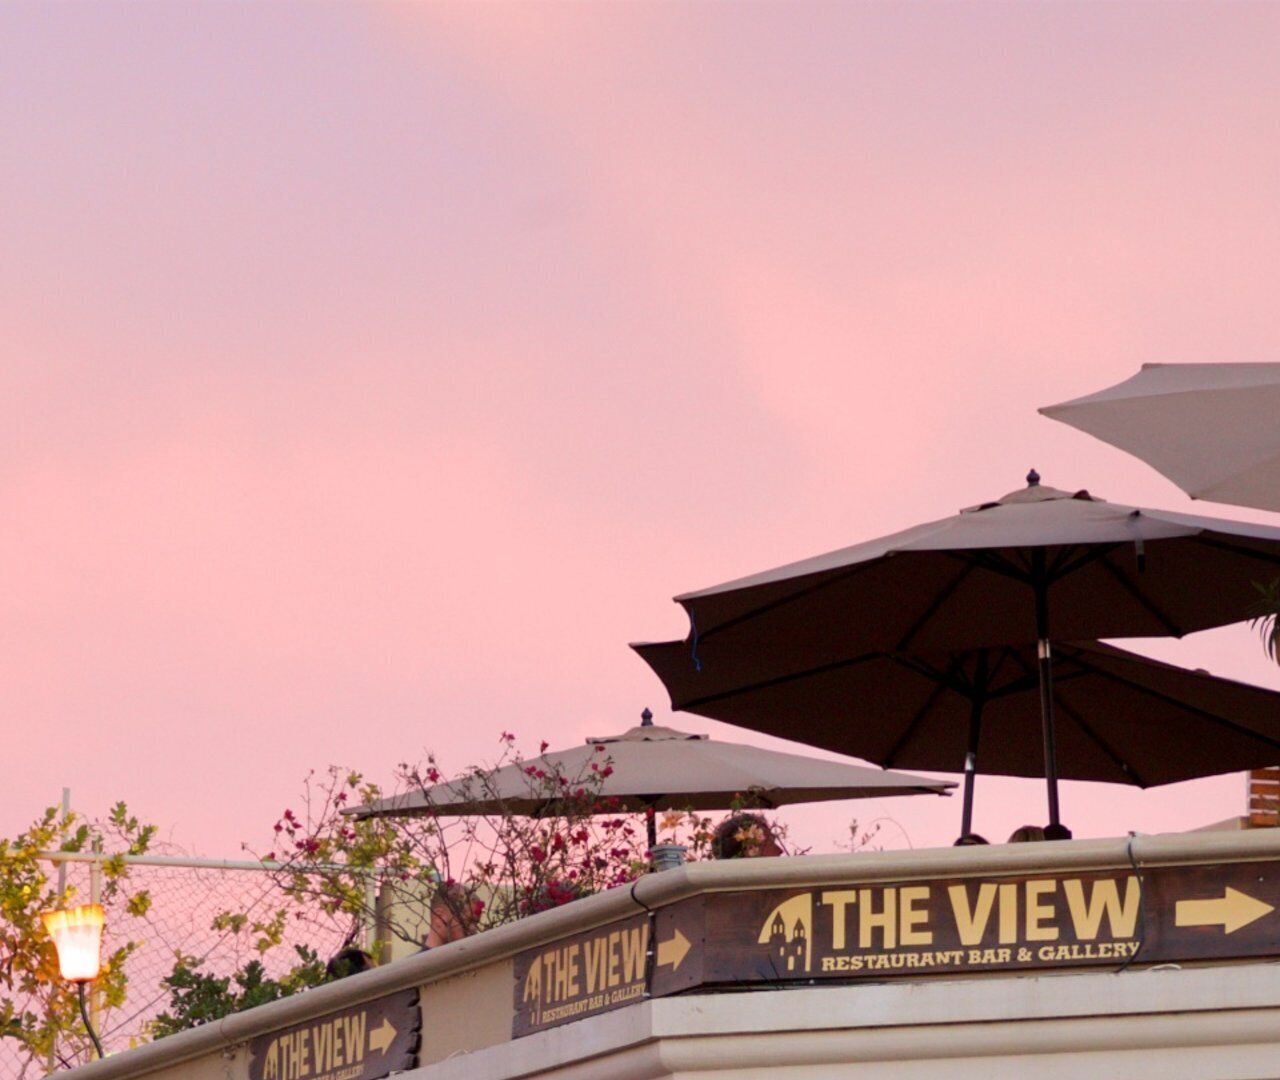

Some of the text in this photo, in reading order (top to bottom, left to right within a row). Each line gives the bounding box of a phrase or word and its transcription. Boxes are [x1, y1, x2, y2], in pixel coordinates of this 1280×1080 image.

[821, 875, 1144, 949] THE VIEW
[543, 925, 649, 1002] THE VIEW
[821, 940, 1143, 973] RESTAURANT BAR & GALLERY
[314, 1011, 367, 1074] VIEW
[542, 999, 589, 1023] RESTAURANT
